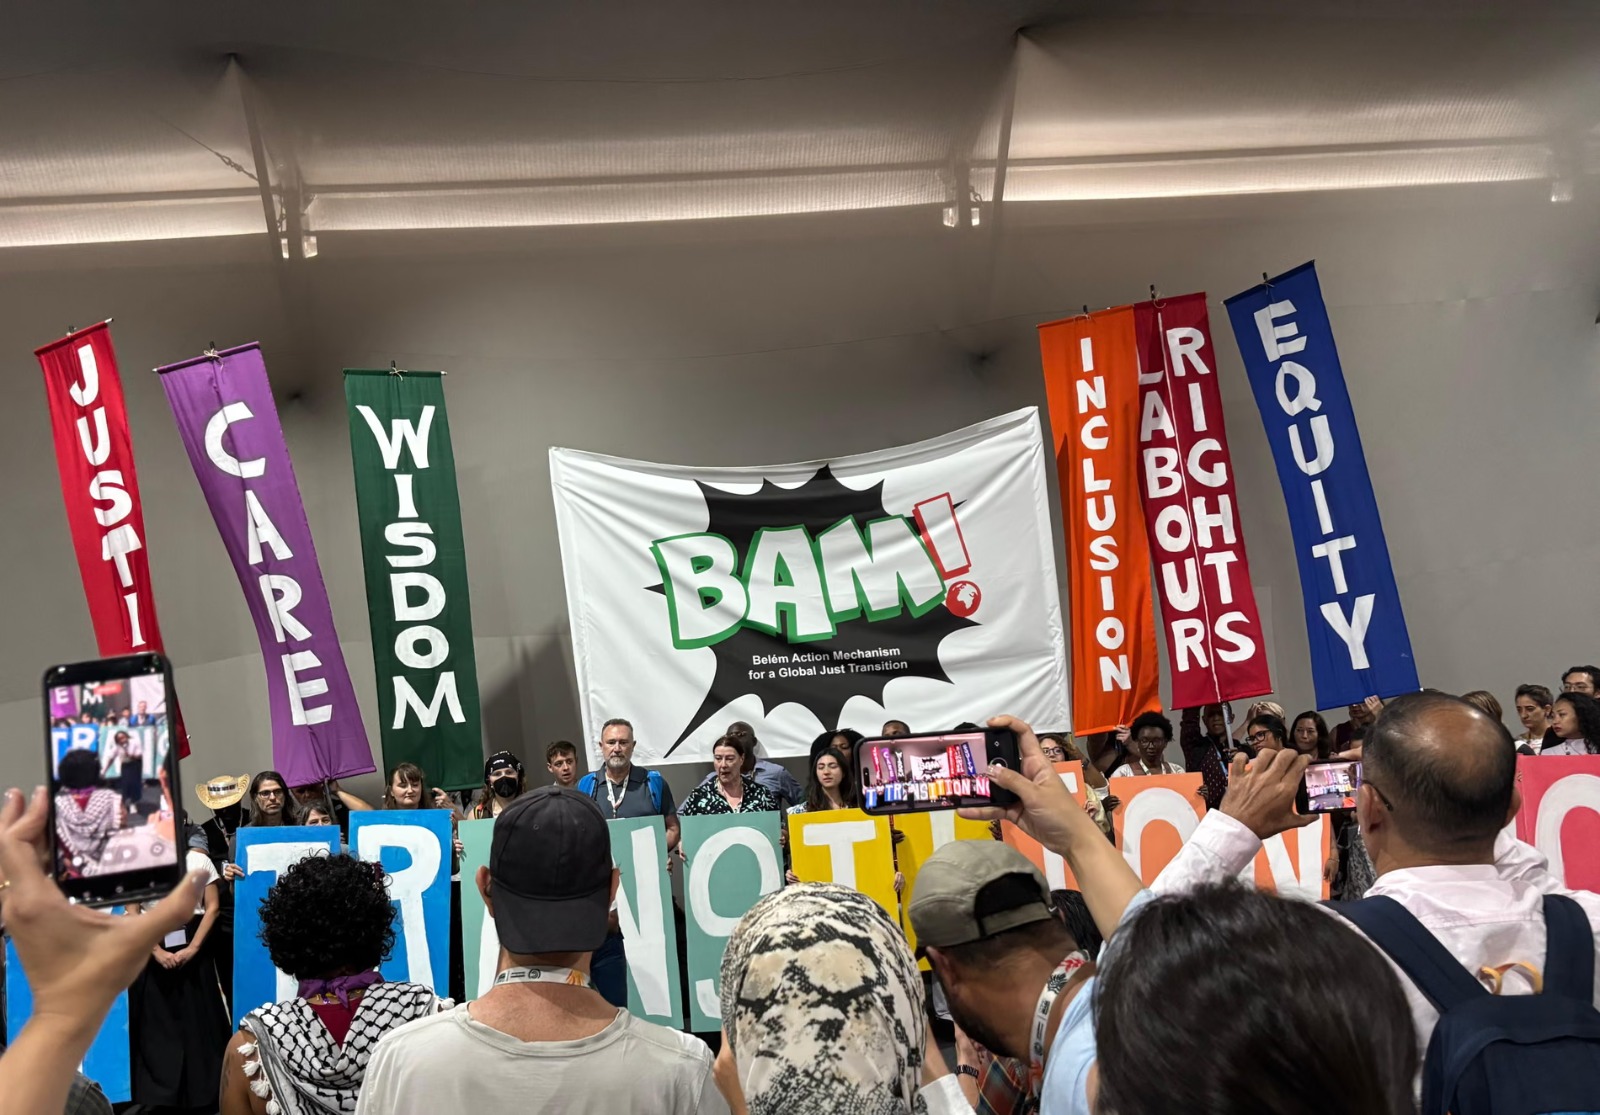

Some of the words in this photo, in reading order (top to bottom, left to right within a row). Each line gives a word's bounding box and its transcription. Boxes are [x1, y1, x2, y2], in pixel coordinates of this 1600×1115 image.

[69, 343, 146, 655] JUSTI
[204, 401, 333, 726] CARE
[356, 404, 467, 730] WISDOM
[649, 491, 982, 650] BAM!
[1075, 336, 1132, 692] INCLUSION
[1165, 326, 1256, 663] RIGHTS
[1253, 299, 1376, 670] EQUITY
[748, 669, 765, 680] for
[768, 670, 776, 679] a
[778, 666, 817, 678] Global
[820, 665, 846, 676] Just
[848, 660, 908, 674] Transition
[752, 653, 789, 666] Belém
[792, 652, 830, 664] Action
[833, 647, 901, 661] Mechanism
